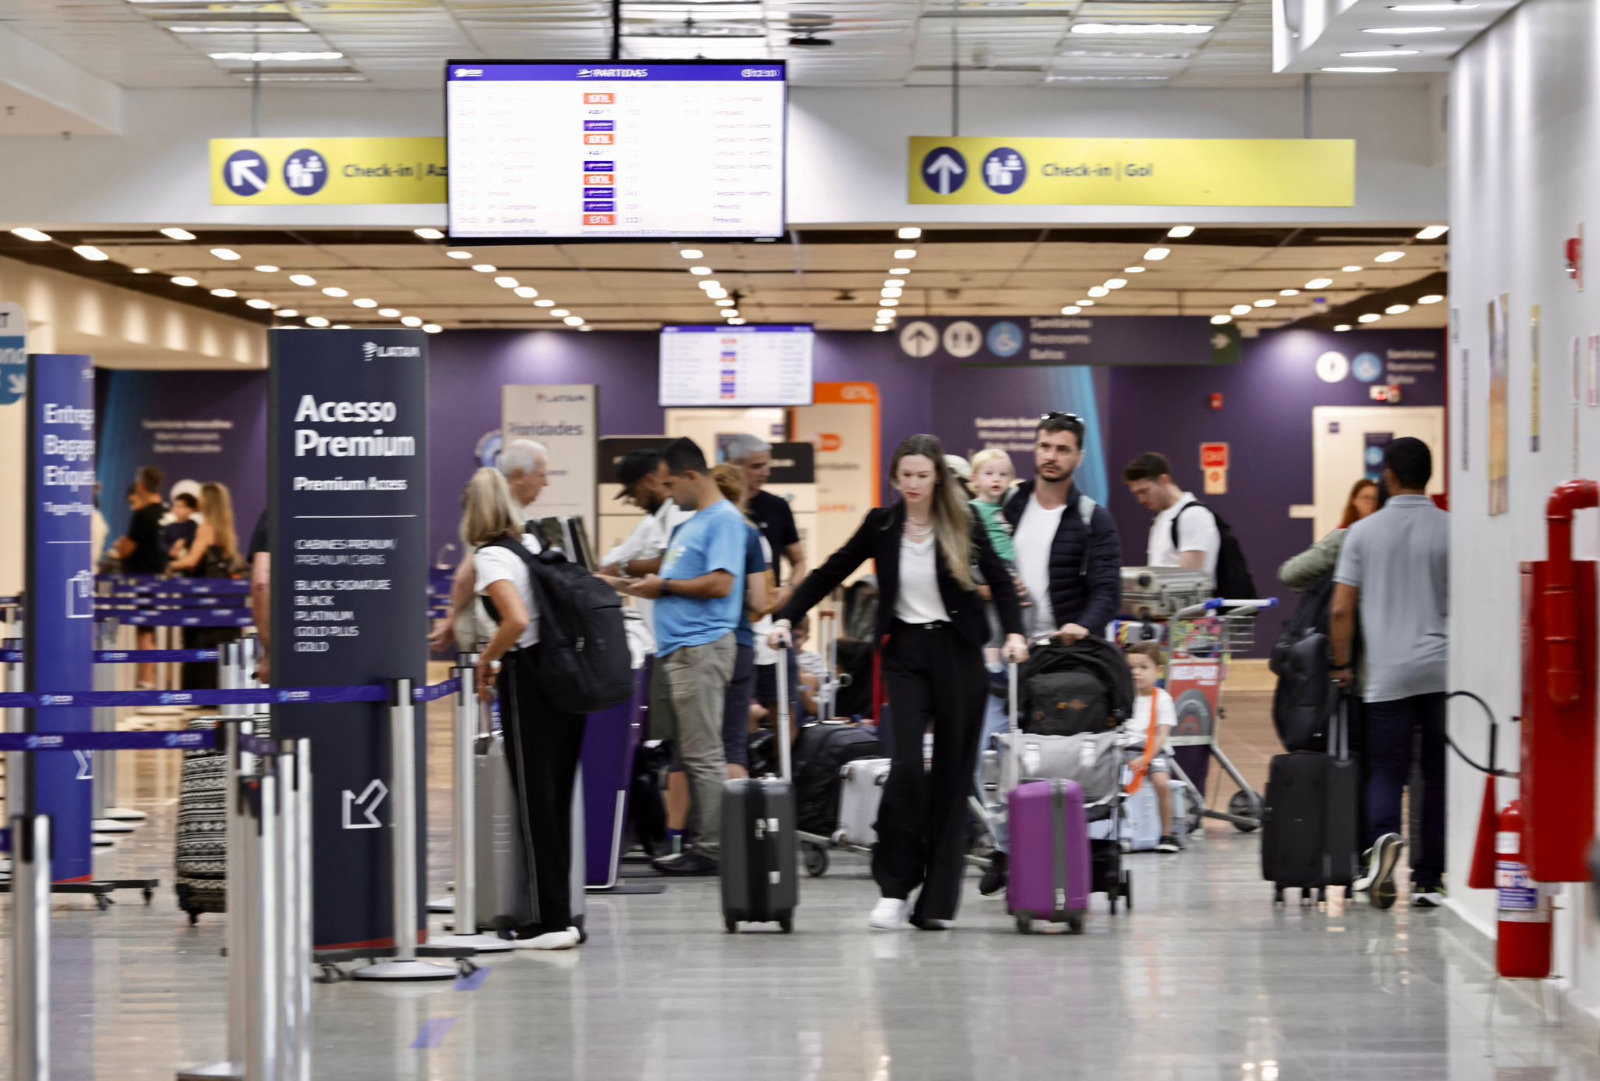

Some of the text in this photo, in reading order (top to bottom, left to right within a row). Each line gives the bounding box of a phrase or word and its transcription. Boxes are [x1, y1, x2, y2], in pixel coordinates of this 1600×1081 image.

[592, 67, 648, 78] PARTIDAS
[342, 163, 413, 178] Check-in
[1041, 163, 1154, 178] Check-in Gol
[294, 394, 398, 423] Acesso
[294, 428, 417, 457] Premium
[293, 476, 408, 491] Premium Access
[294, 580, 334, 590] BLACK
[294, 595, 335, 606] BLACK
[294, 610, 355, 621] PLATINUM
[293, 641, 330, 652] GOLD
